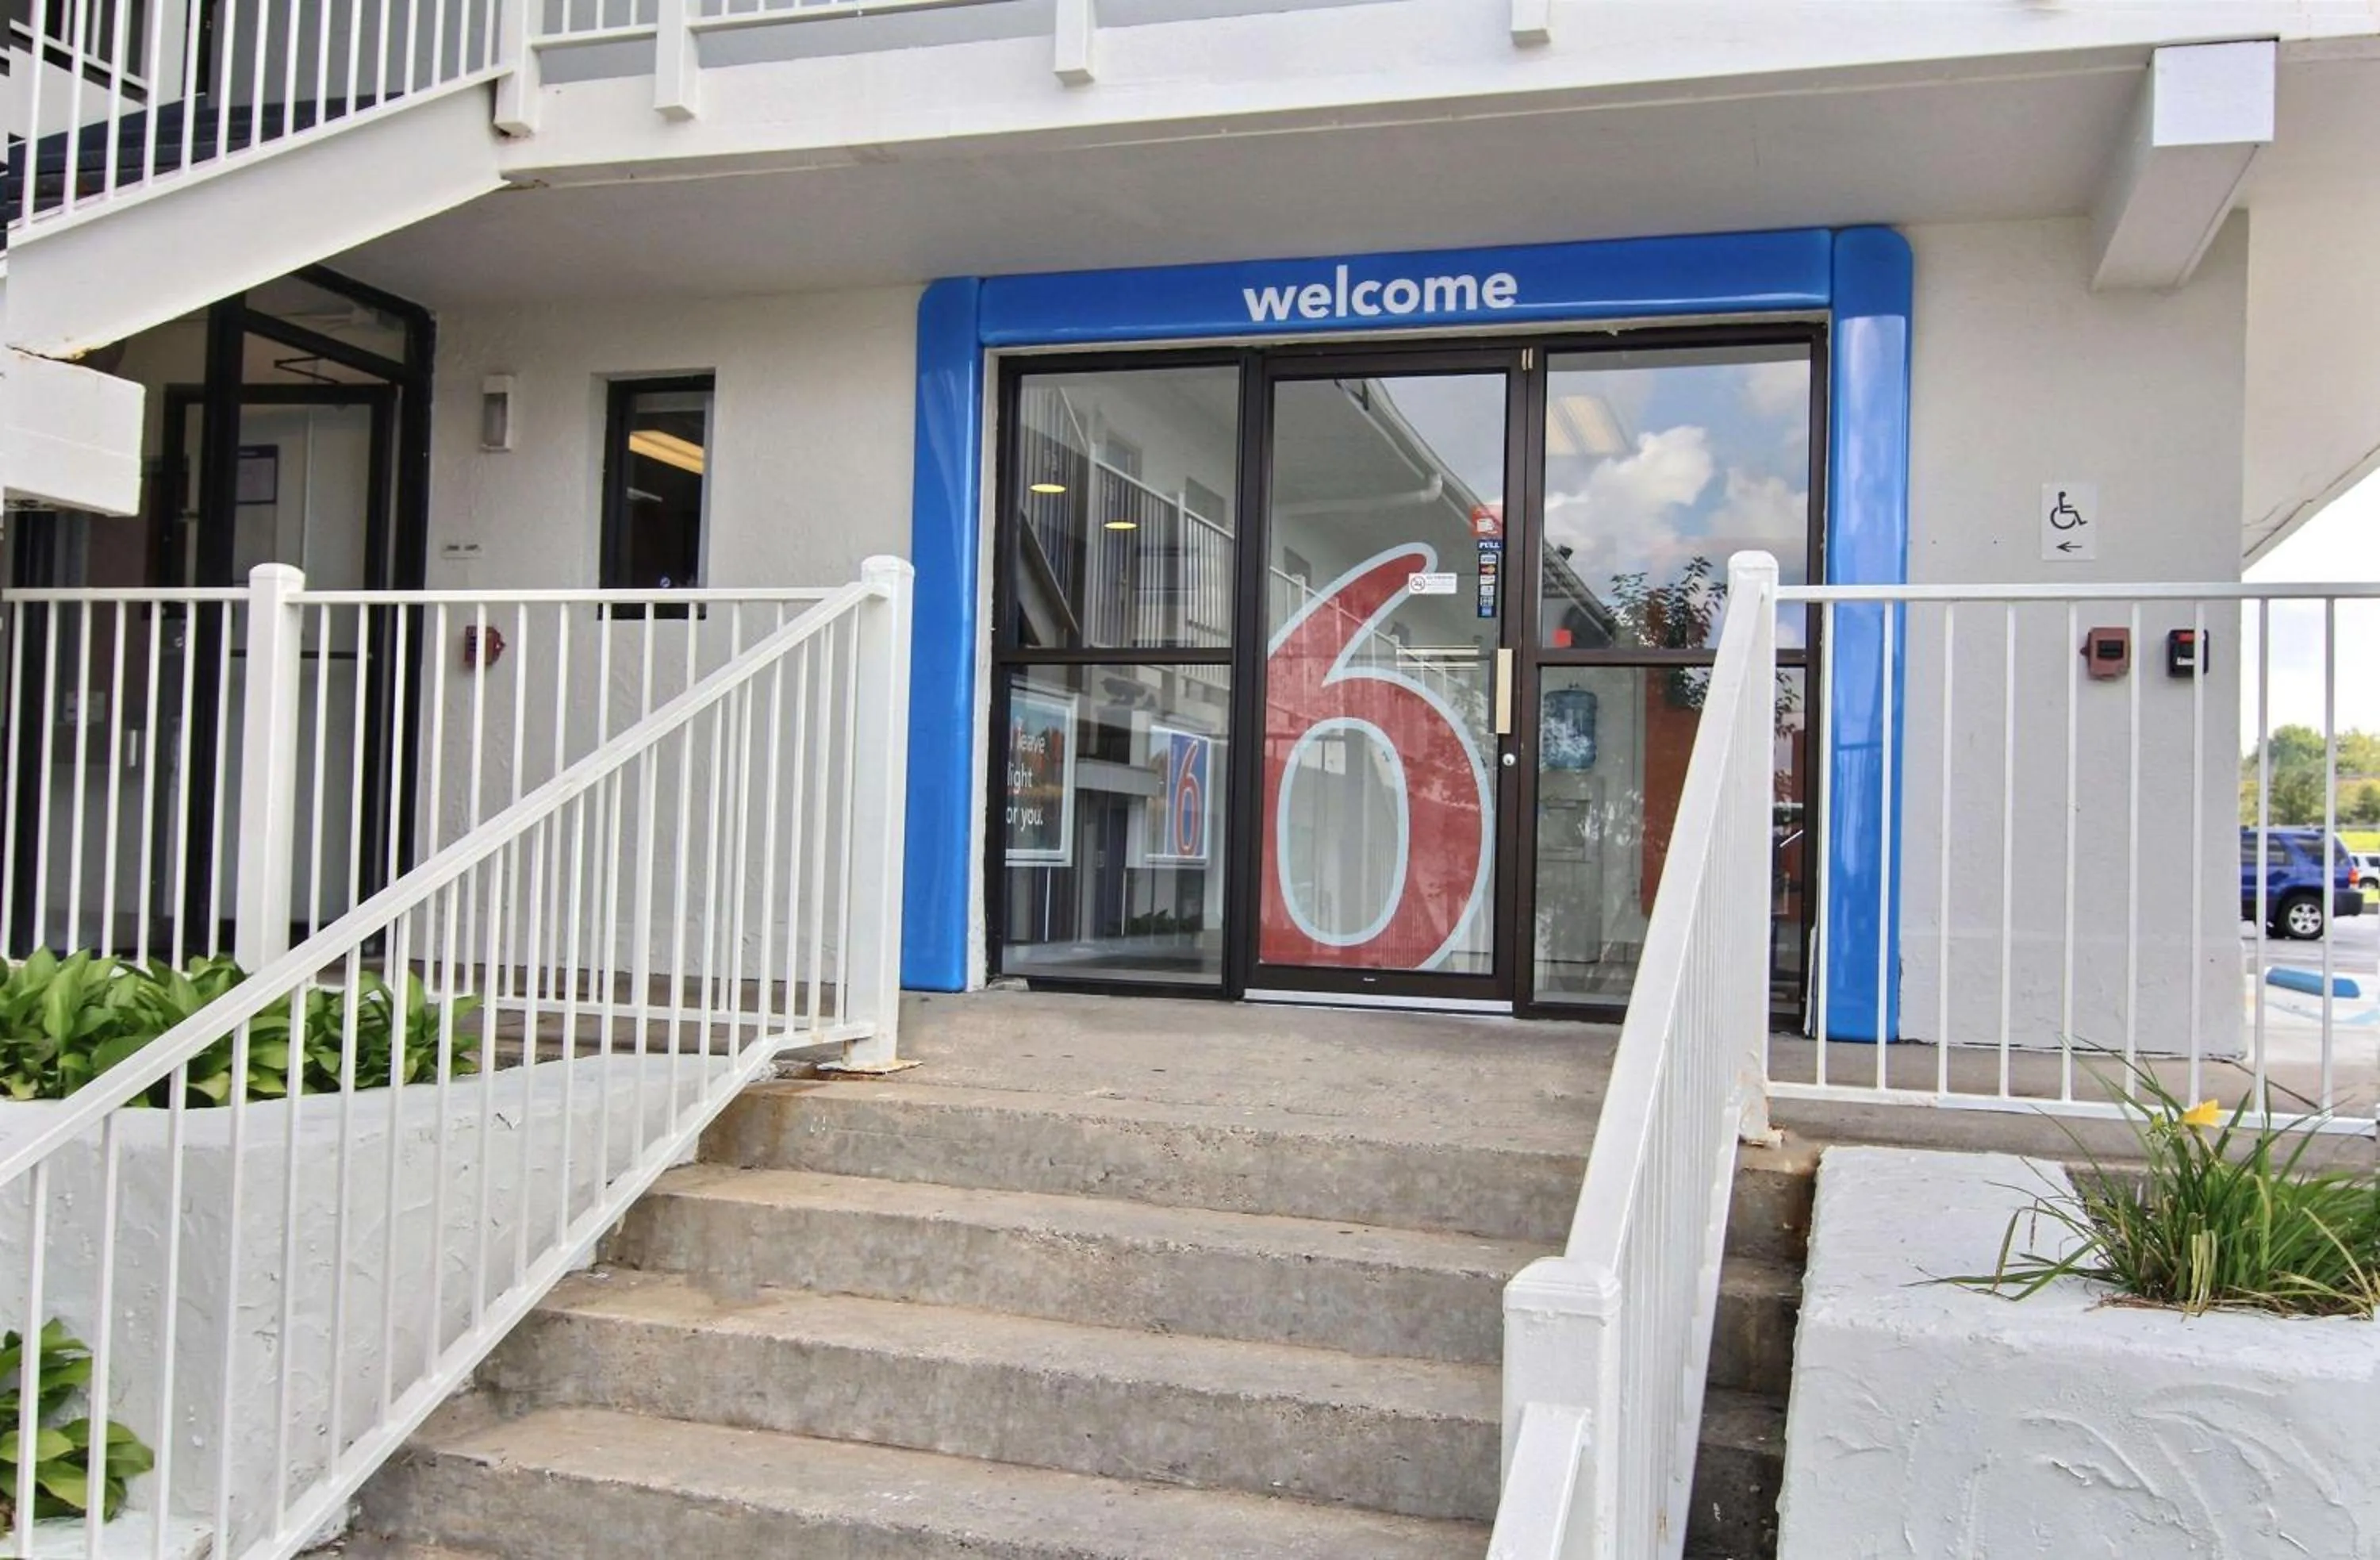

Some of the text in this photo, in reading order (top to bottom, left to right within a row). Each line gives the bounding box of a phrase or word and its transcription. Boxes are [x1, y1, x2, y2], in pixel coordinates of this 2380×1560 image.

[1243, 265, 1518, 321] welcome
[1016, 726, 1046, 754] leave
[1259, 541, 1494, 970] 6
[1007, 761, 1033, 795] light
[1174, 739, 1202, 858] 6
[1005, 805, 1044, 832] or you.
